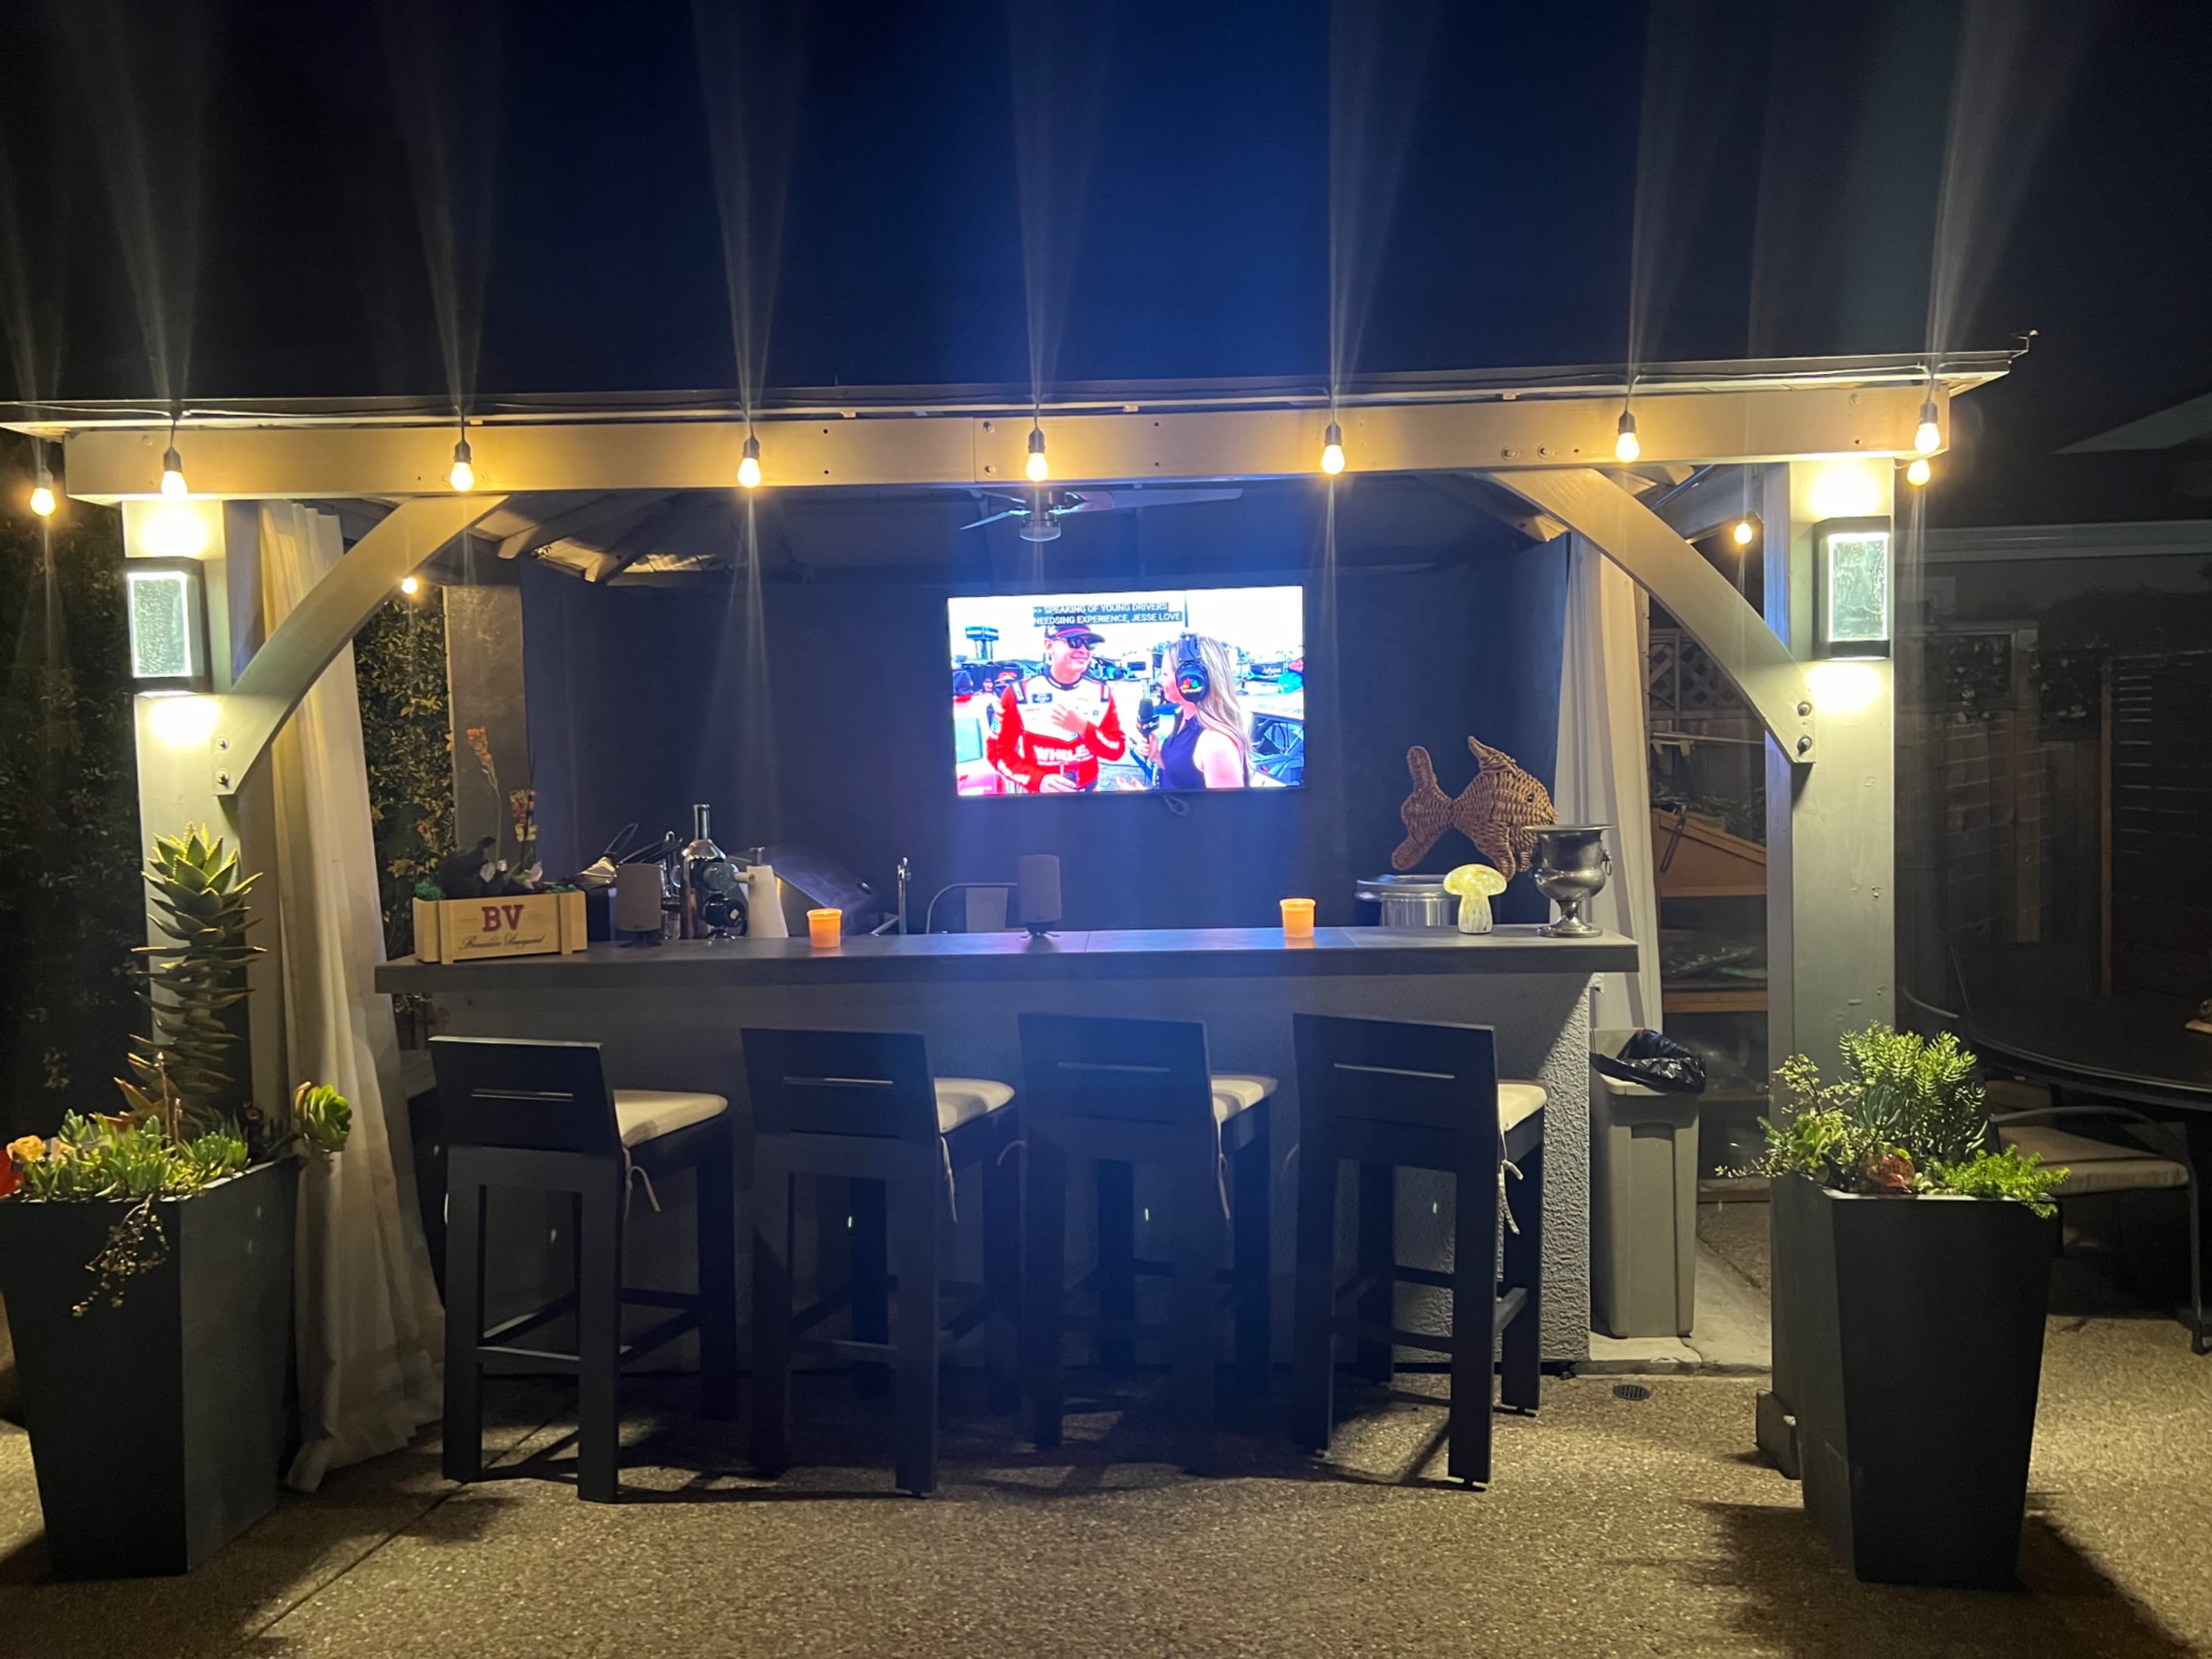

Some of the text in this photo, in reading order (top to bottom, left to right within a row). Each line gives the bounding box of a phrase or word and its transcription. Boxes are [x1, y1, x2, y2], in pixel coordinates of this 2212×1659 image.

[1044, 605, 1085, 613] SPEAKING
[1101, 603, 1130, 612] YOUNG
[1131, 603, 1167, 611] DRIVERS
[1131, 613, 1156, 621] JESSE
[1159, 612, 1180, 620] LOVE
[482, 904, 524, 932] BV
